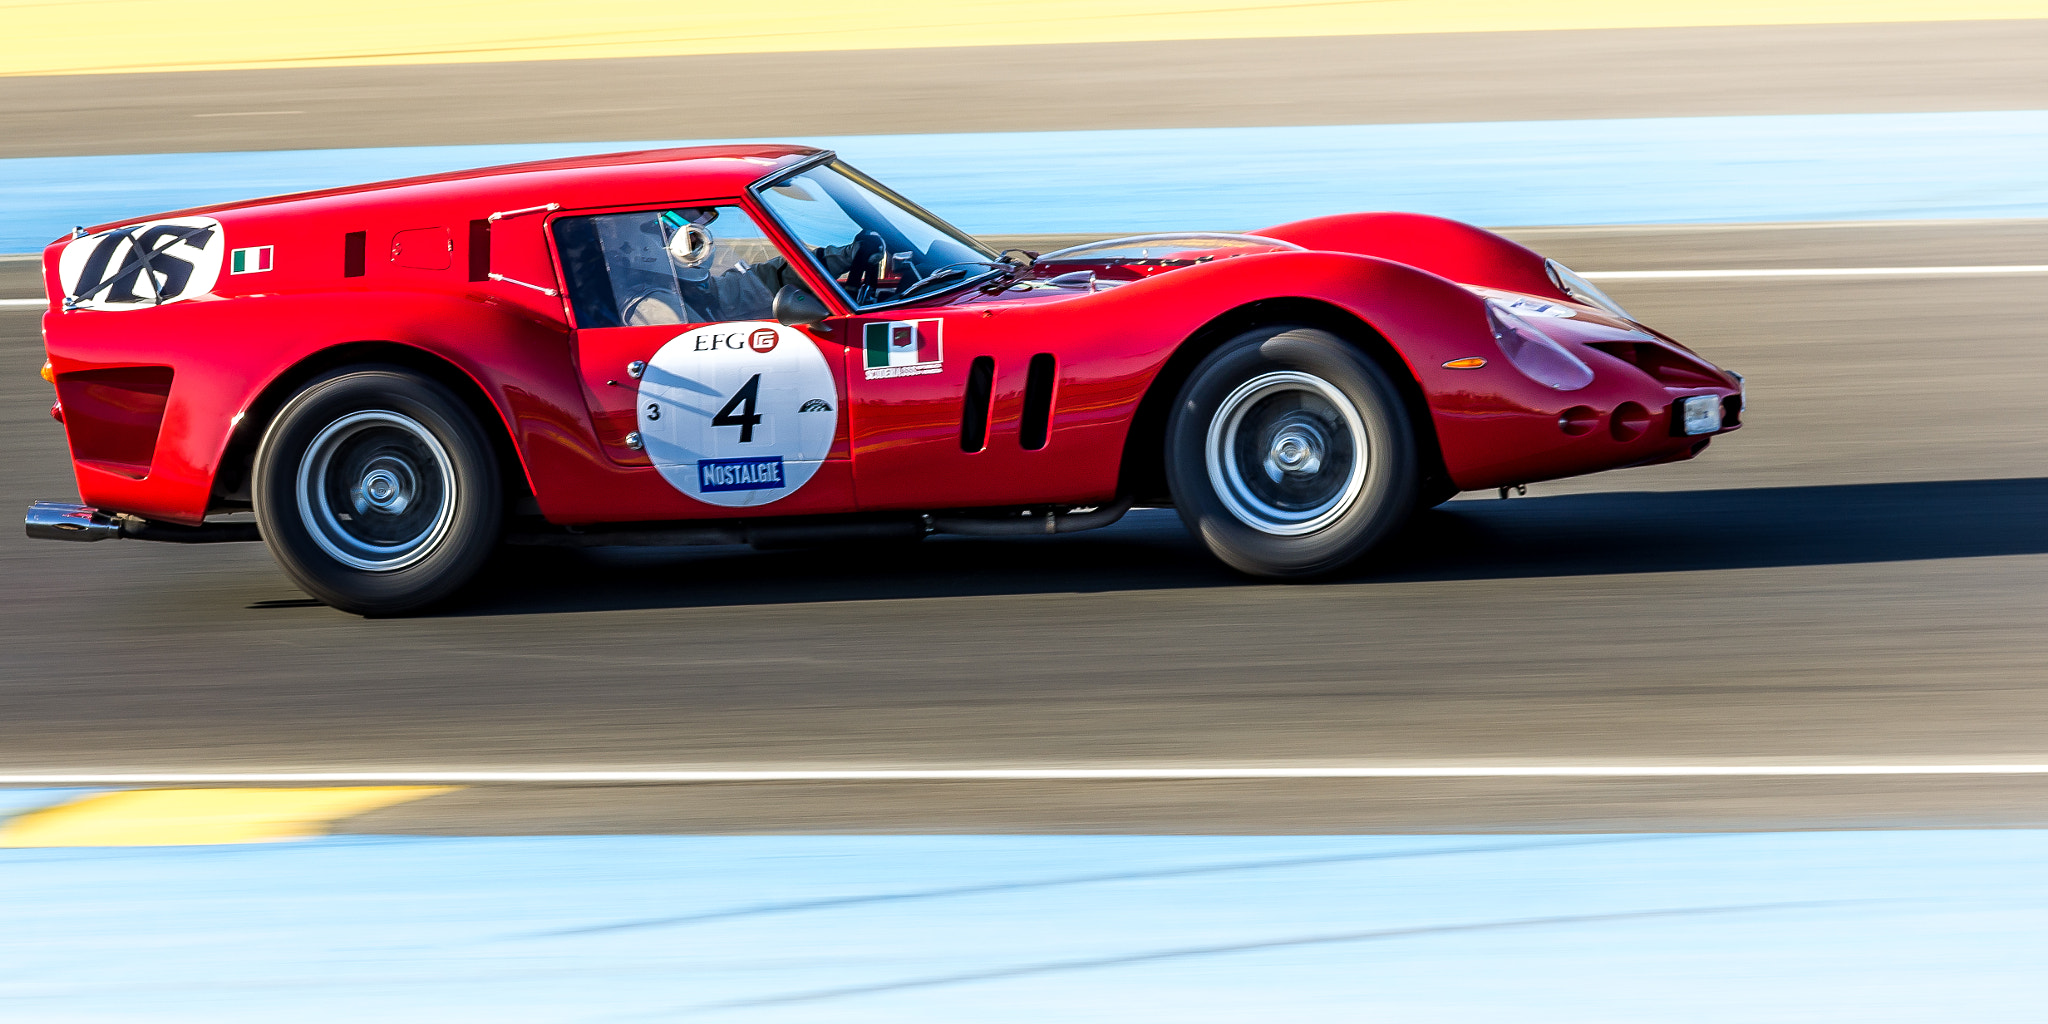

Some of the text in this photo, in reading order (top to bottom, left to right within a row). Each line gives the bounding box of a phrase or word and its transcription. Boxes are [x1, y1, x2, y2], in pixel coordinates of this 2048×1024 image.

[73, 225, 215, 303] 16
[693, 332, 745, 352] EFG
[647, 403, 661, 421] 3
[711, 373, 762, 443] 4
[703, 462, 781, 486] NOSTALGIE
